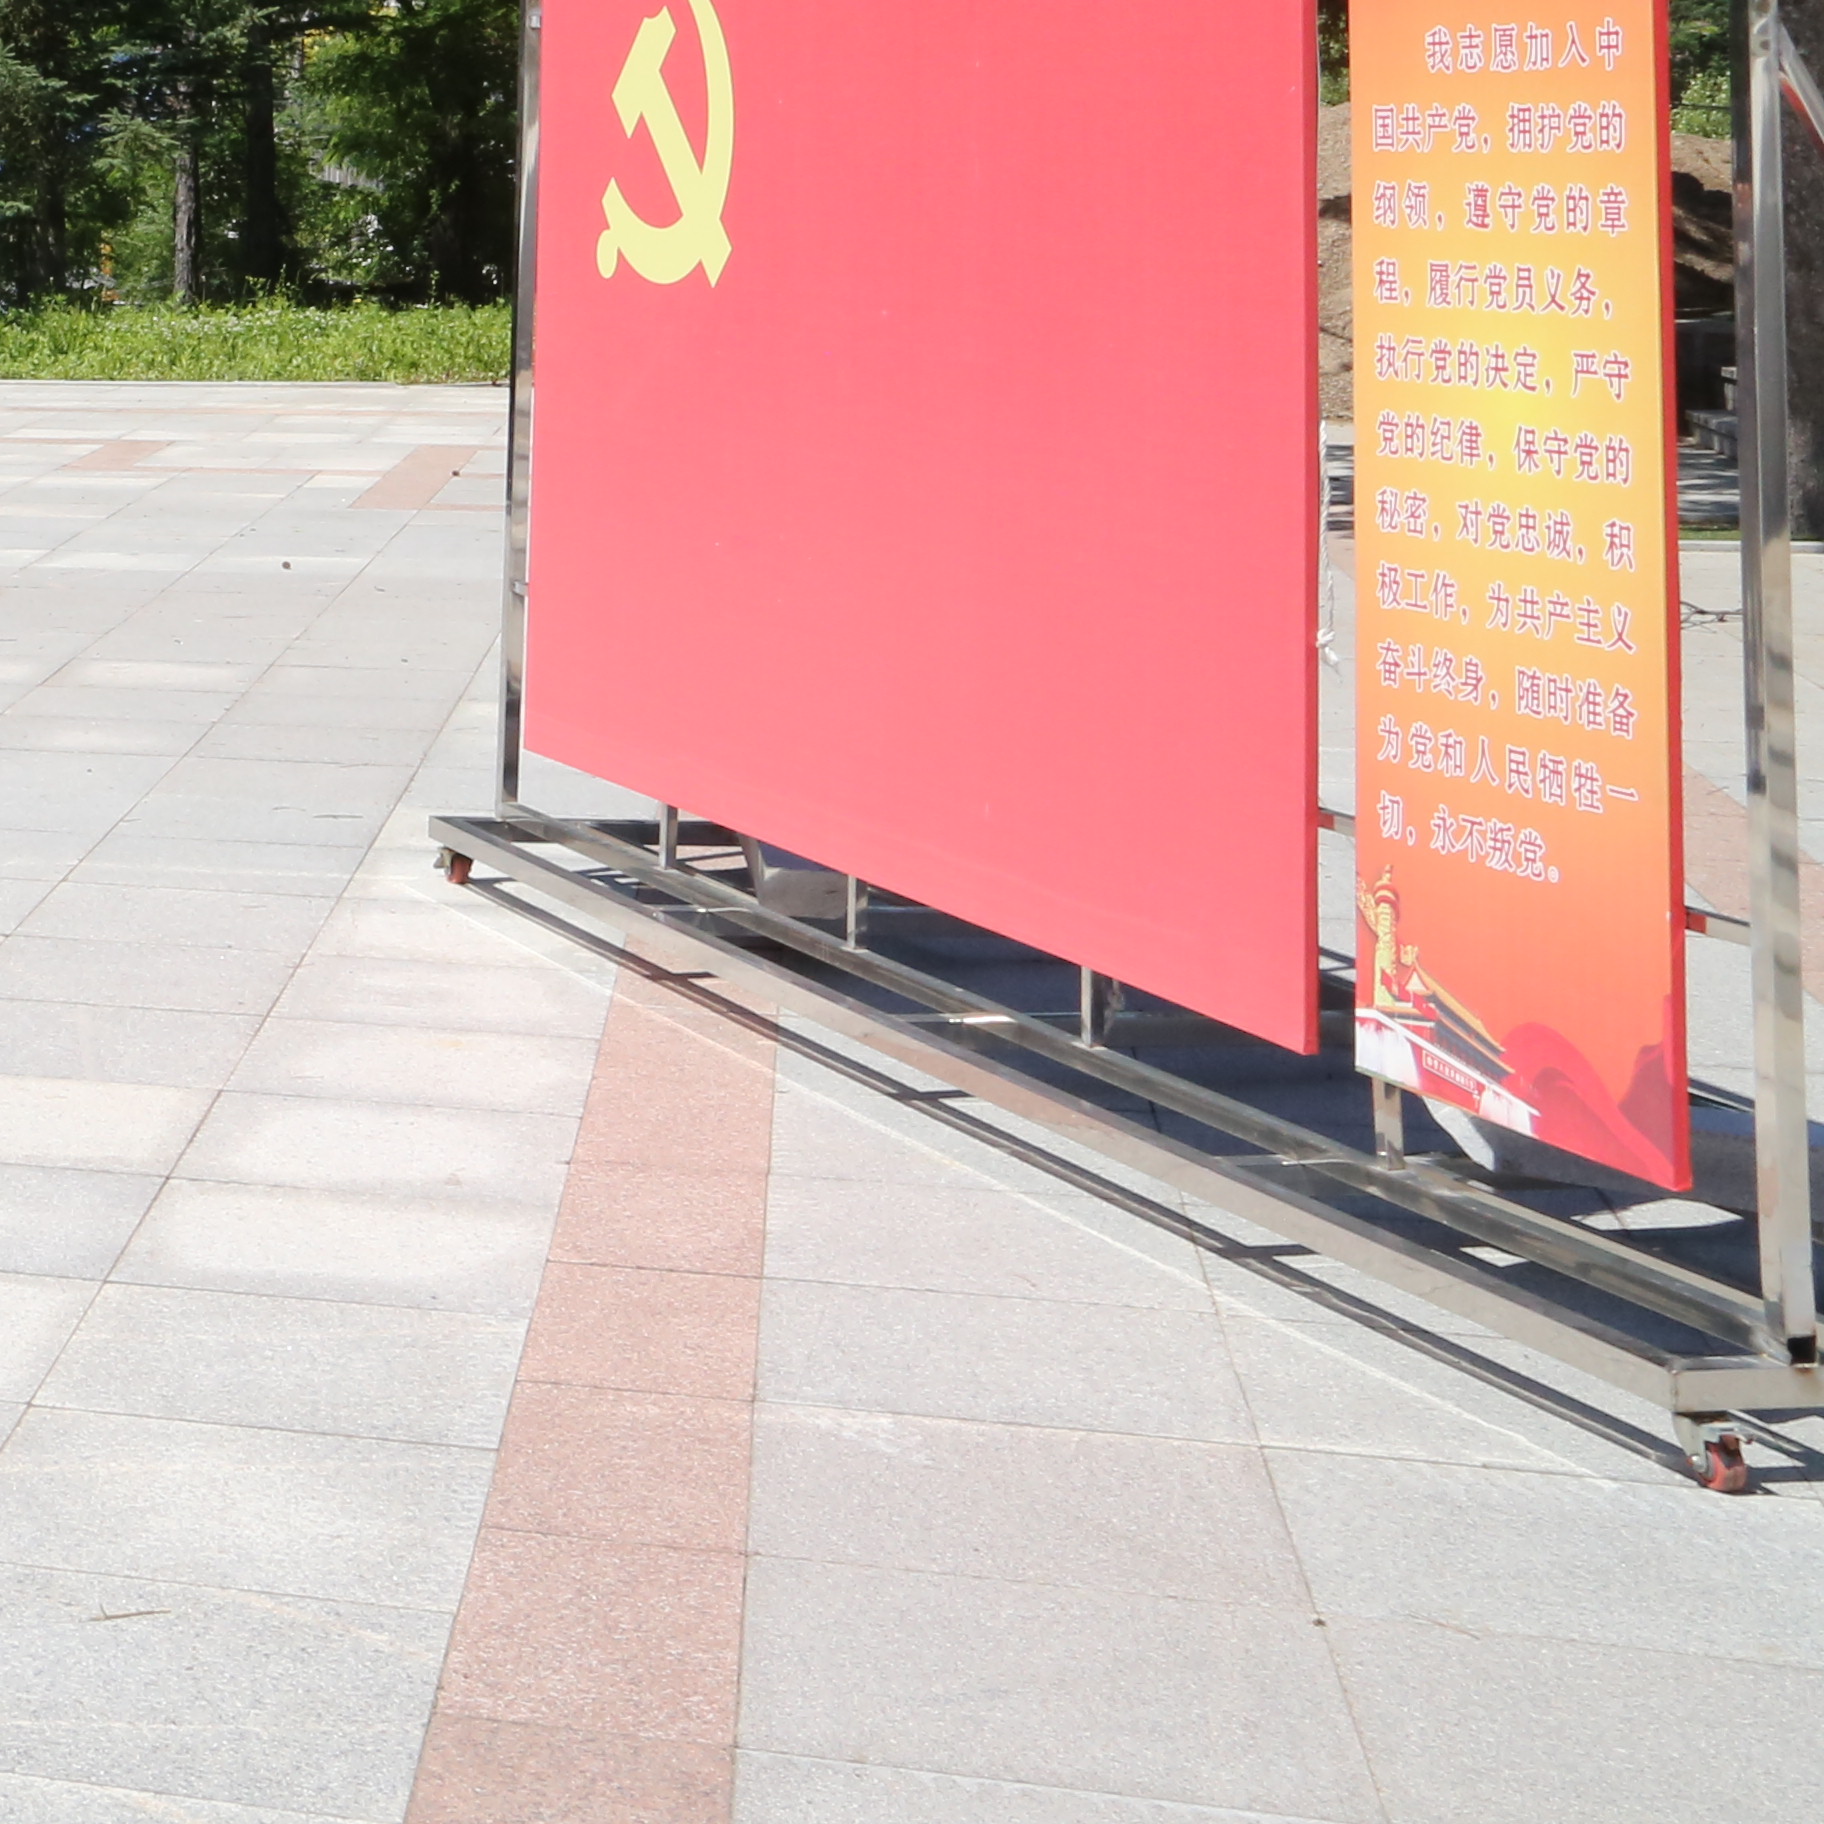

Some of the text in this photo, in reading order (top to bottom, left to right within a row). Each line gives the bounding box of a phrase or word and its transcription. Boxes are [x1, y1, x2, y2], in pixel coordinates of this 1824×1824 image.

[1426, 18, 1623, 72] 我志愿加入中
[1372, 101, 1625, 153] 国共产党，拥护党的
[1374, 181, 1629, 236] 纲领，遵守党的章
[1375, 258, 1613, 318] 程，履行党员义务，
[1376, 334, 1631, 401] 执行党的决定，严守
[1376, 410, 1632, 486] 党的纪律，保守党的
[1376, 487, 1636, 572] 秘密，对党忠诚，积
[1377, 562, 1637, 654] 极工作，为共产主义
[1377, 640, 1638, 740] 奋斗终身，随时准备
[1378, 716, 1639, 813] 为党和人民牺牲一
[1378, 791, 1560, 883] 切，永不叛党。
